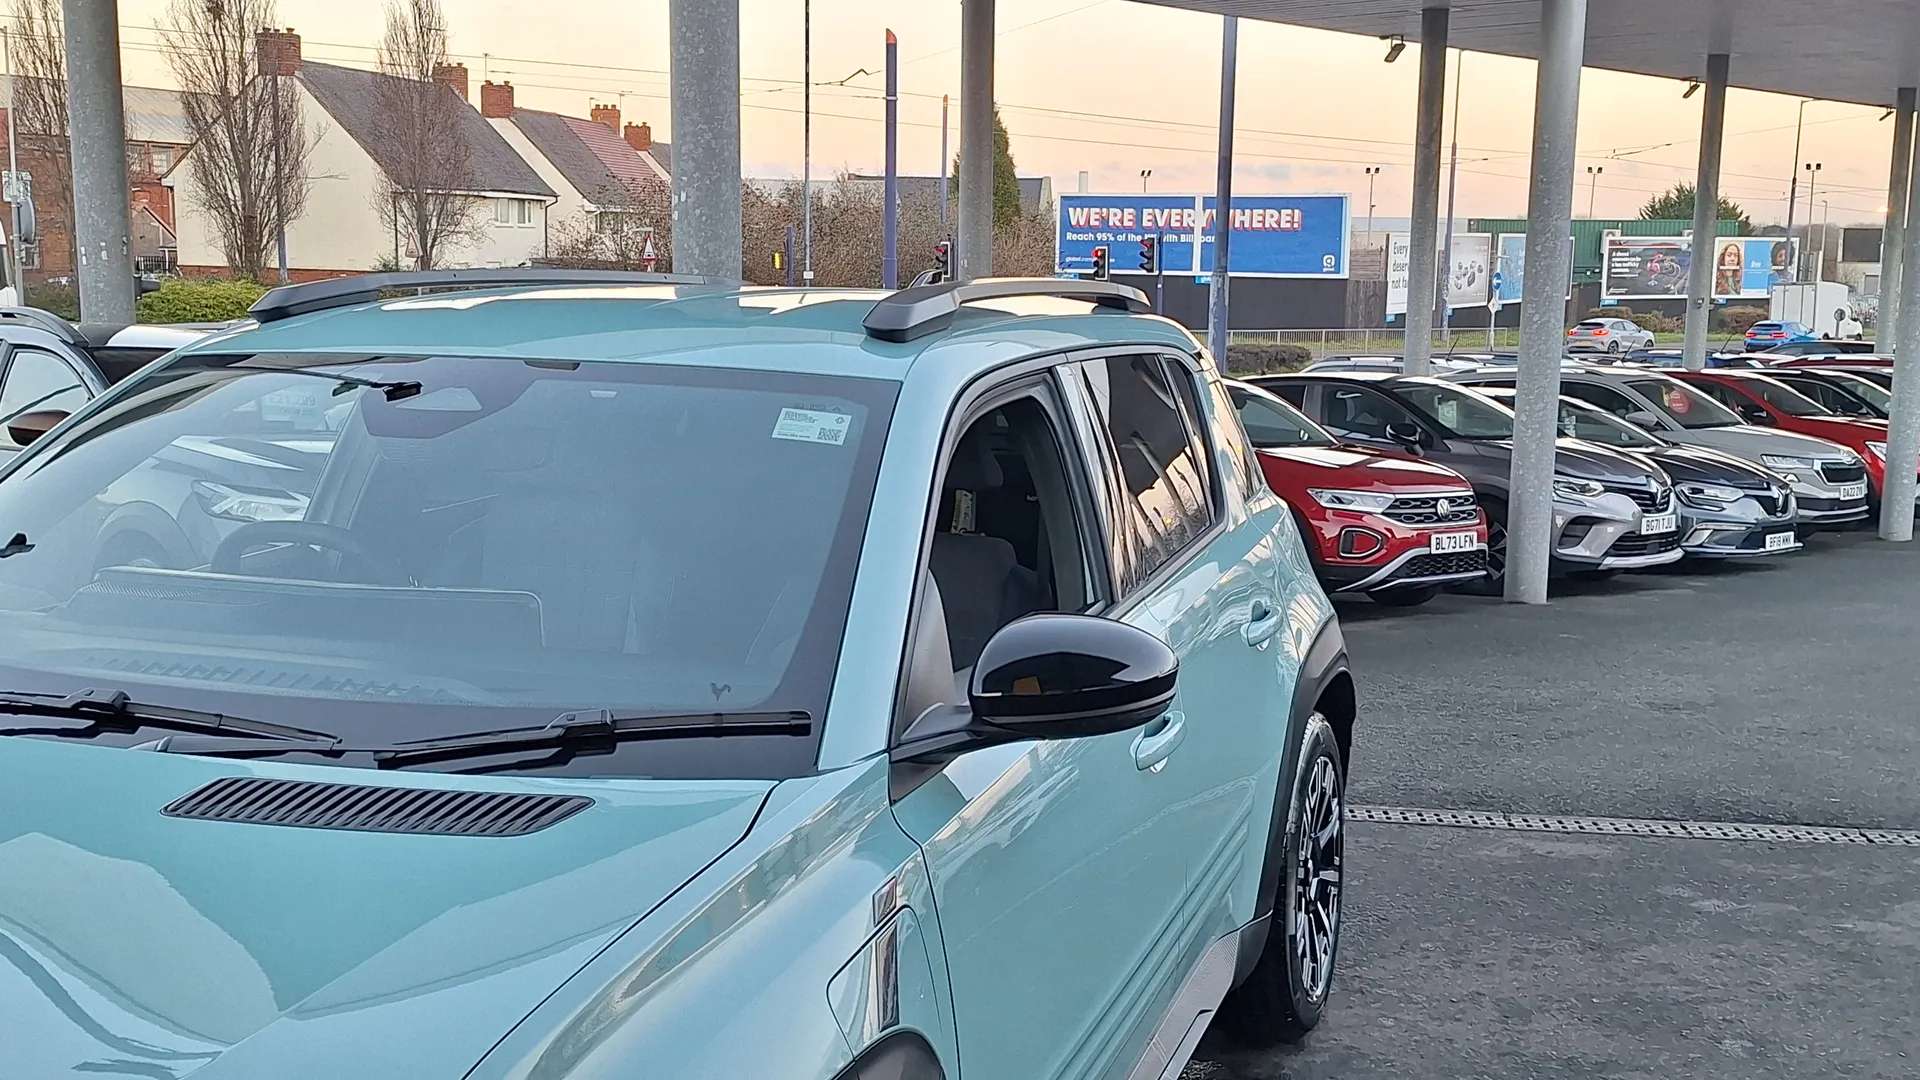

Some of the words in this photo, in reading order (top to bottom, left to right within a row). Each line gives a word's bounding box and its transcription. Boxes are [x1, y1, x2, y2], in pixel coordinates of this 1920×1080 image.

[1068, 207, 1136, 229] WE'RE
[1142, 207, 1301, 231] EVERYHERE!
[1066, 232, 1094, 241] Reach
[1096, 232, 1114, 242] 95%
[1117, 232, 1126, 242] of
[1127, 233, 1142, 242] the
[1393, 258, 1408, 273] deser
[1646, 519, 1661, 532] BG71
[1435, 535, 1457, 551] BL73
[1458, 534, 1474, 549] LFN
